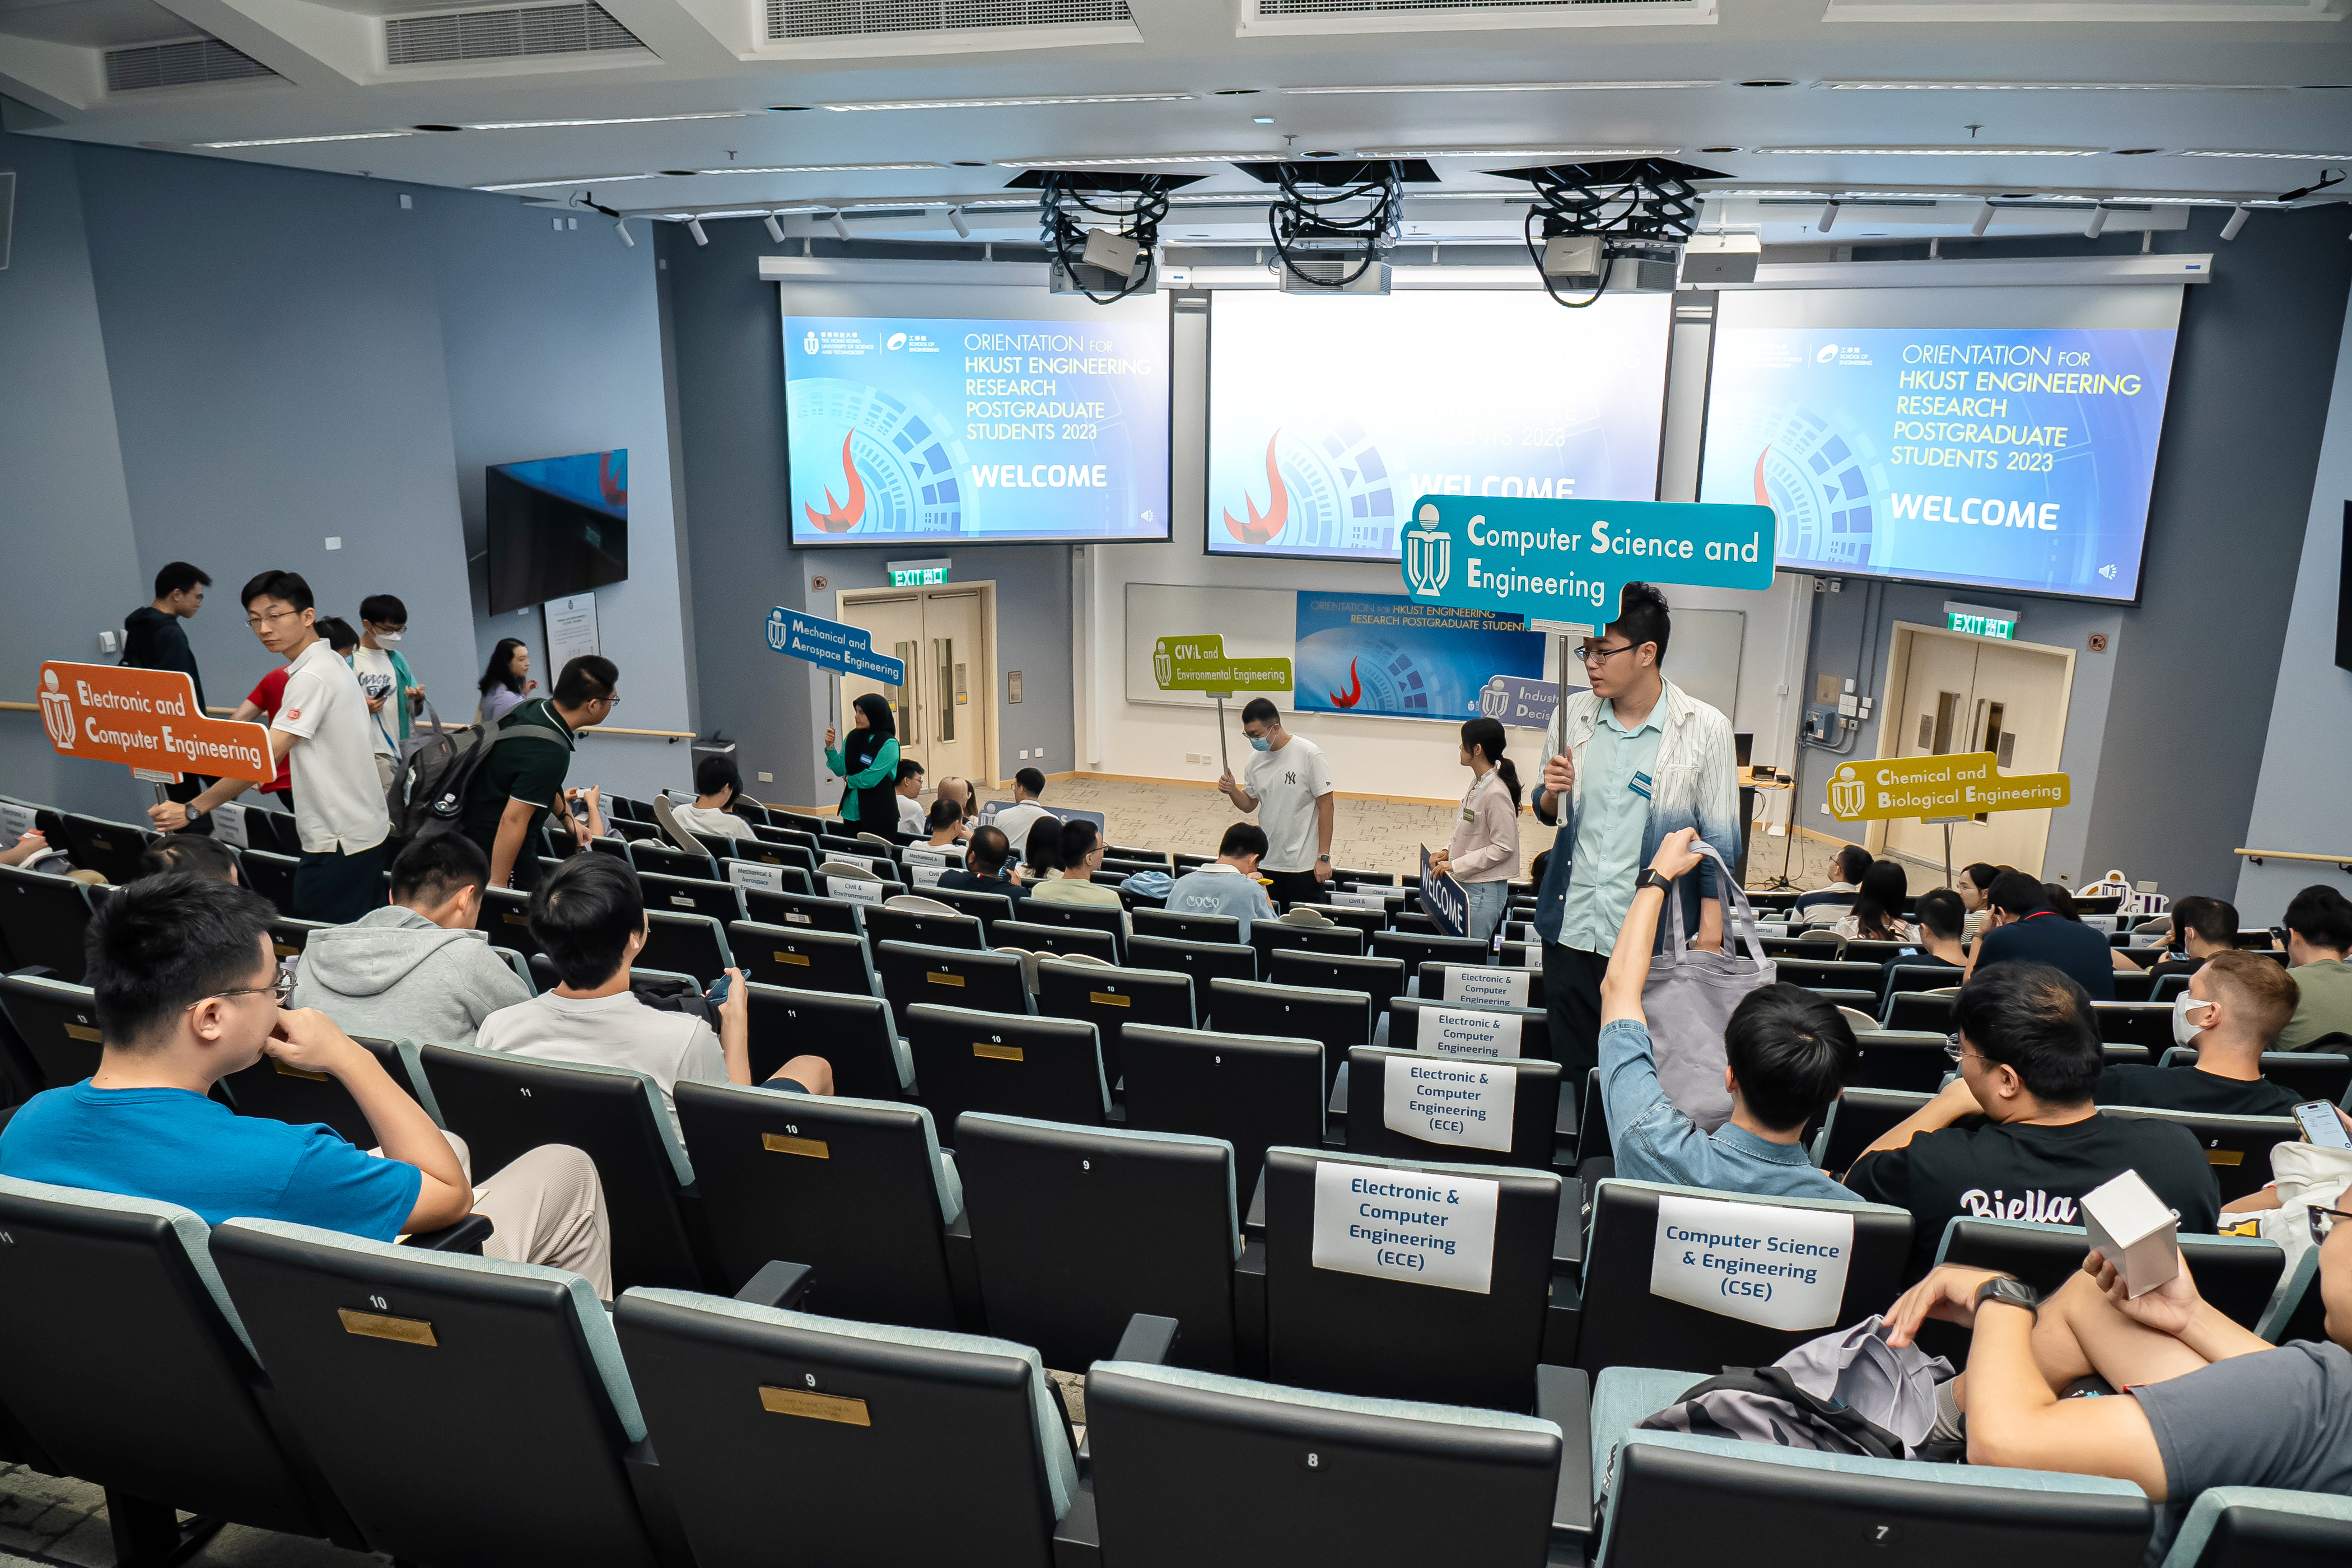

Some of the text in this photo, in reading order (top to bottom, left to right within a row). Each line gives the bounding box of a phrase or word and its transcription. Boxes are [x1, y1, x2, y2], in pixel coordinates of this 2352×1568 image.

[964, 334, 1113, 352] ORIENTATION FOR
[1902, 344, 2090, 367] ORIENTATION FOR
[965, 357, 1151, 375] HKUST ENGINEERING
[966, 379, 1056, 396] RESEARCH
[1899, 370, 2141, 395] HKUST ENGINEERING
[967, 402, 1104, 418] POSTGRADUATE
[1897, 395, 2007, 417] RESEARCH
[967, 423, 1096, 440] STUDENTS 2023
[1522, 427, 1566, 447] 2023
[1893, 421, 2068, 447] POSTGRADUATE
[1891, 446, 2054, 472] STUDENTS 2023
[972, 465, 1107, 487] WELCOME
[1410, 473, 1576, 498] WELCOME
[1891, 492, 2060, 530] WELCOME
[1467, 515, 1759, 562] Computer Science and
[896, 568, 942, 586] EXIT 出口
[1467, 558, 1605, 606] Engineering
[1311, 601, 1374, 613] ORIENTATION
[1393, 605, 1424, 615] HKUST
[1426, 606, 1496, 618] ENGINEERING
[1351, 615, 1399, 625] RESEARCH
[1403, 617, 1480, 629] POSTGRADUATE
[1953, 613, 2009, 638] EXIT 出口
[792, 619, 866, 651] Mechanical and
[792, 637, 899, 680] Aerospace Engineering
[1203, 645, 1218, 659] and
[1177, 666, 1285, 684] Environmental Engineering
[77, 680, 185, 716] Electronic and
[1519, 687, 1559, 704] Industr
[1516, 704, 1553, 720] Decis
[85, 716, 262, 769] Computer Engineering
[1285, 771, 1296, 785] NY
[1877, 764, 1986, 785] Chemical and
[1878, 785, 2061, 809] Biological Engineering
[738, 868, 767, 877] Mechanical
[741, 876, 769, 885] Aerospace
[834, 890, 874, 901] Environmental
[1422, 860, 1463, 934] WELCOME
[1462, 973, 1503, 984] Electronic
[1466, 985, 1506, 995] Computer
[1460, 995, 1510, 1006] Engineering
[77, 1015, 88, 1024] 13
[1439, 1015, 1500, 1029] Electronic &
[1444, 1029, 1494, 1042] Computer
[1438, 1042, 1499, 1057] Engineering
[1411, 1067, 1489, 1084] Electronic &
[520, 1088, 532, 1097] 11
[1416, 1085, 1481, 1100] Computer
[1410, 1100, 1486, 1121] Engineering
[786, 1124, 798, 1134] 10
[1429, 1118, 1464, 1135] (ECE)
[1082, 1160, 1090, 1170] 9
[1351, 1178, 1459, 1205] Electronic &
[1360, 1203, 1449, 1226] Computer
[1961, 1189, 2077, 1224] Biella
[1350, 1224, 1456, 1255] Engineering
[1667, 1226, 1840, 1258] Computer Science
[1377, 1249, 1424, 1271] (ECE)
[1683, 1251, 1817, 1284] & Engineering
[1721, 1277, 1772, 1302] (CSE)
[370, 1295, 387, 1309] 10
[805, 1373, 816, 1387] 9
[1308, 1453, 1318, 1467] 8
[1876, 1525, 1889, 1539] 7
